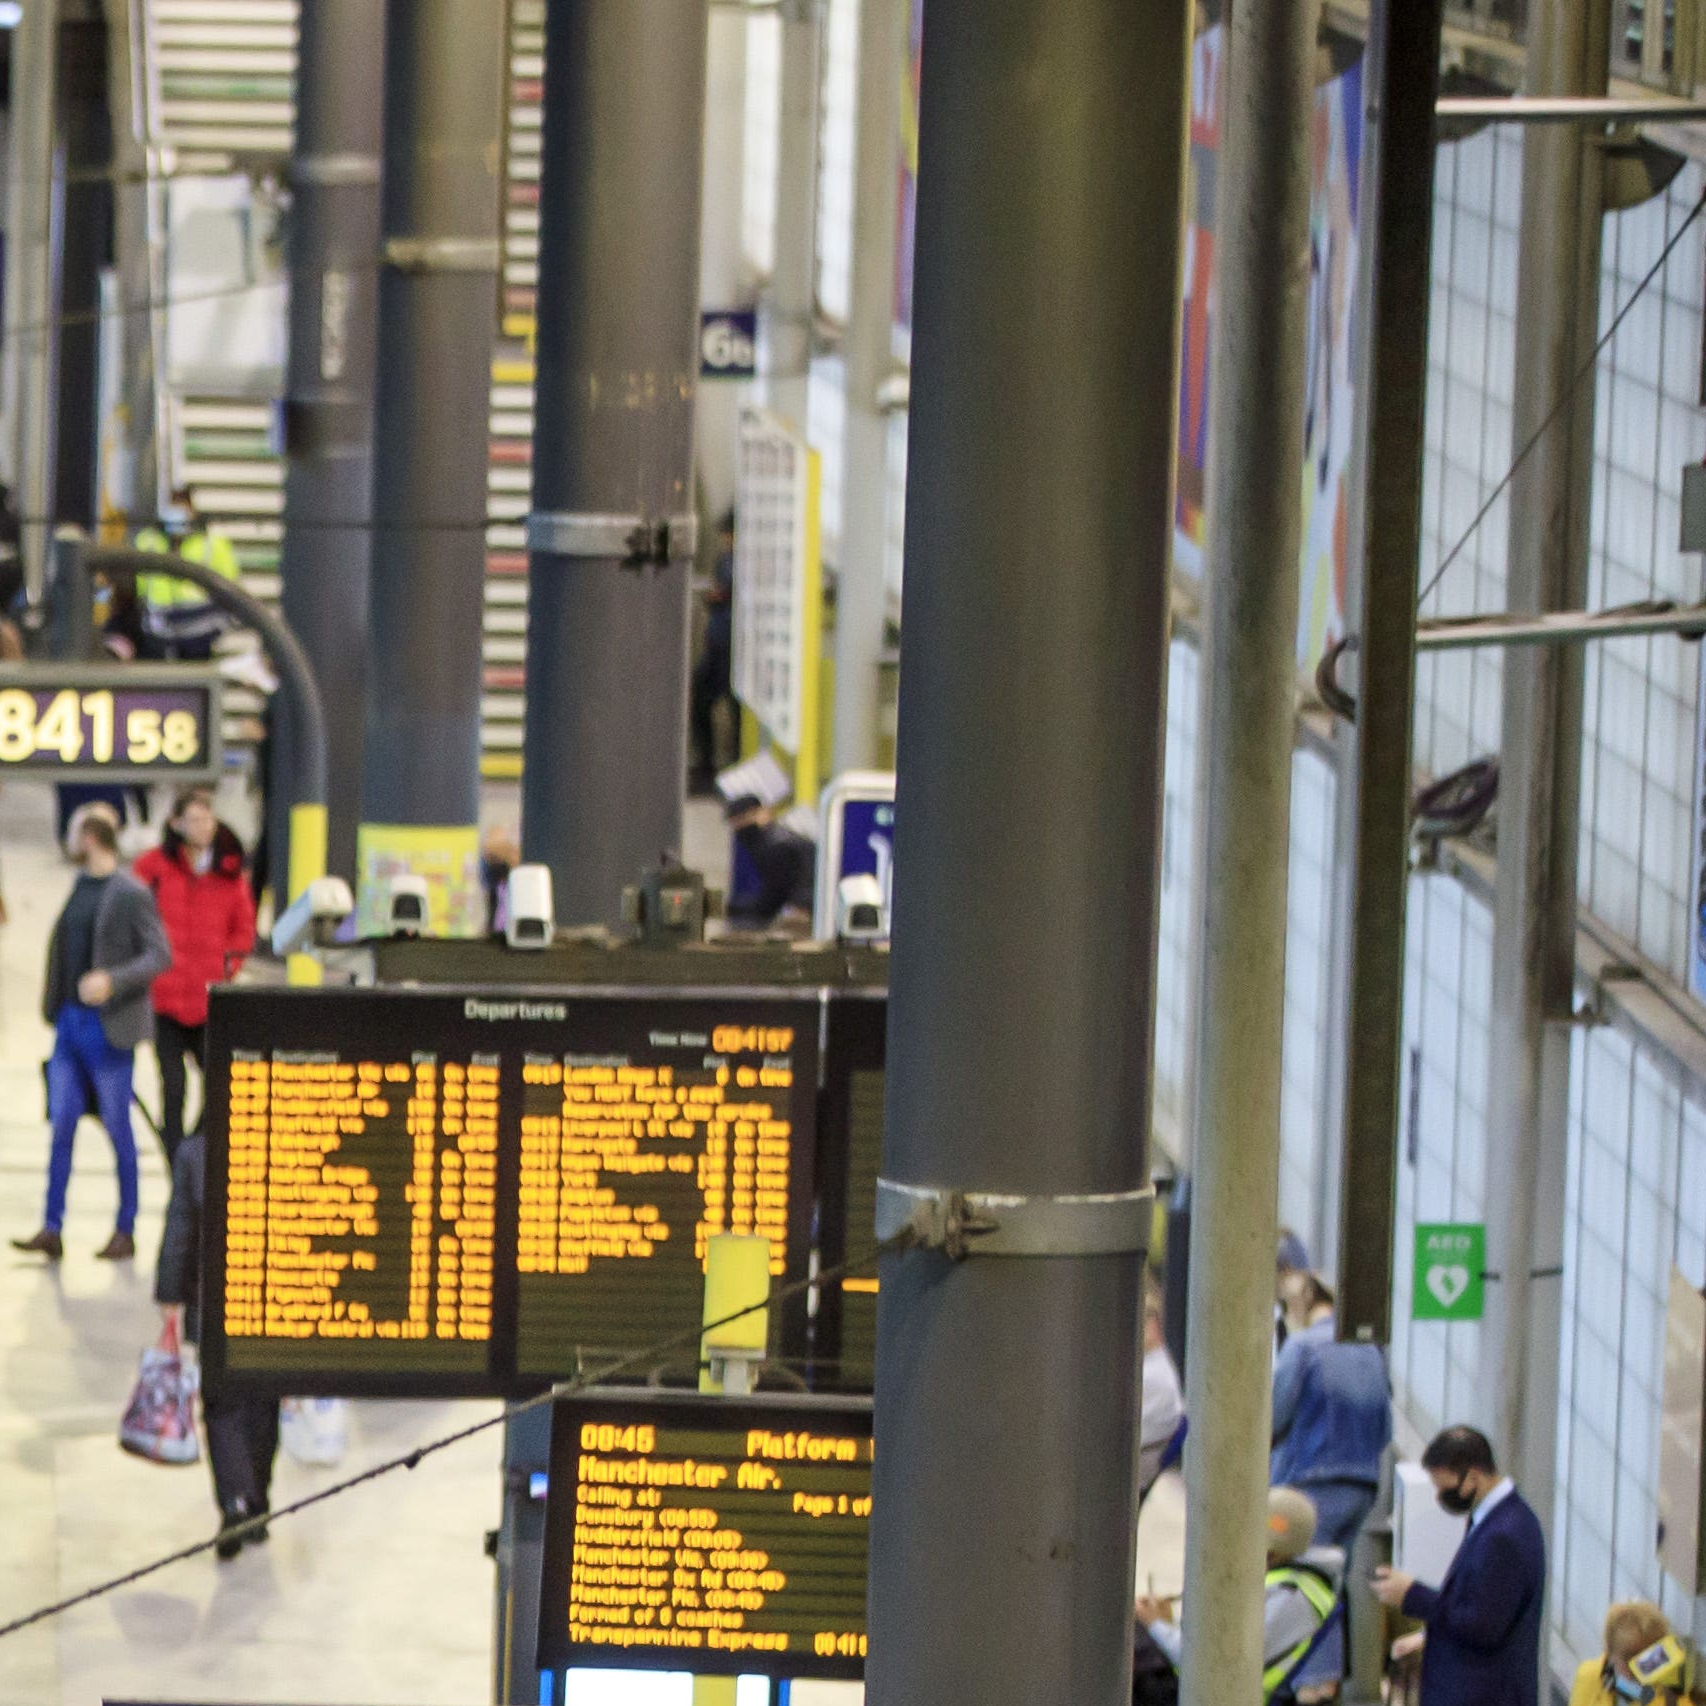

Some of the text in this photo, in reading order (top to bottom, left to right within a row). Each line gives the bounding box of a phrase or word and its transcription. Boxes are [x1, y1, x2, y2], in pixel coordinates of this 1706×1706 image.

[126, 708, 200, 763] 58
[465, 999, 566, 1022] Departures
[747, 1429, 857, 1462] Platform
[578, 1455, 727, 1488] Manchester
